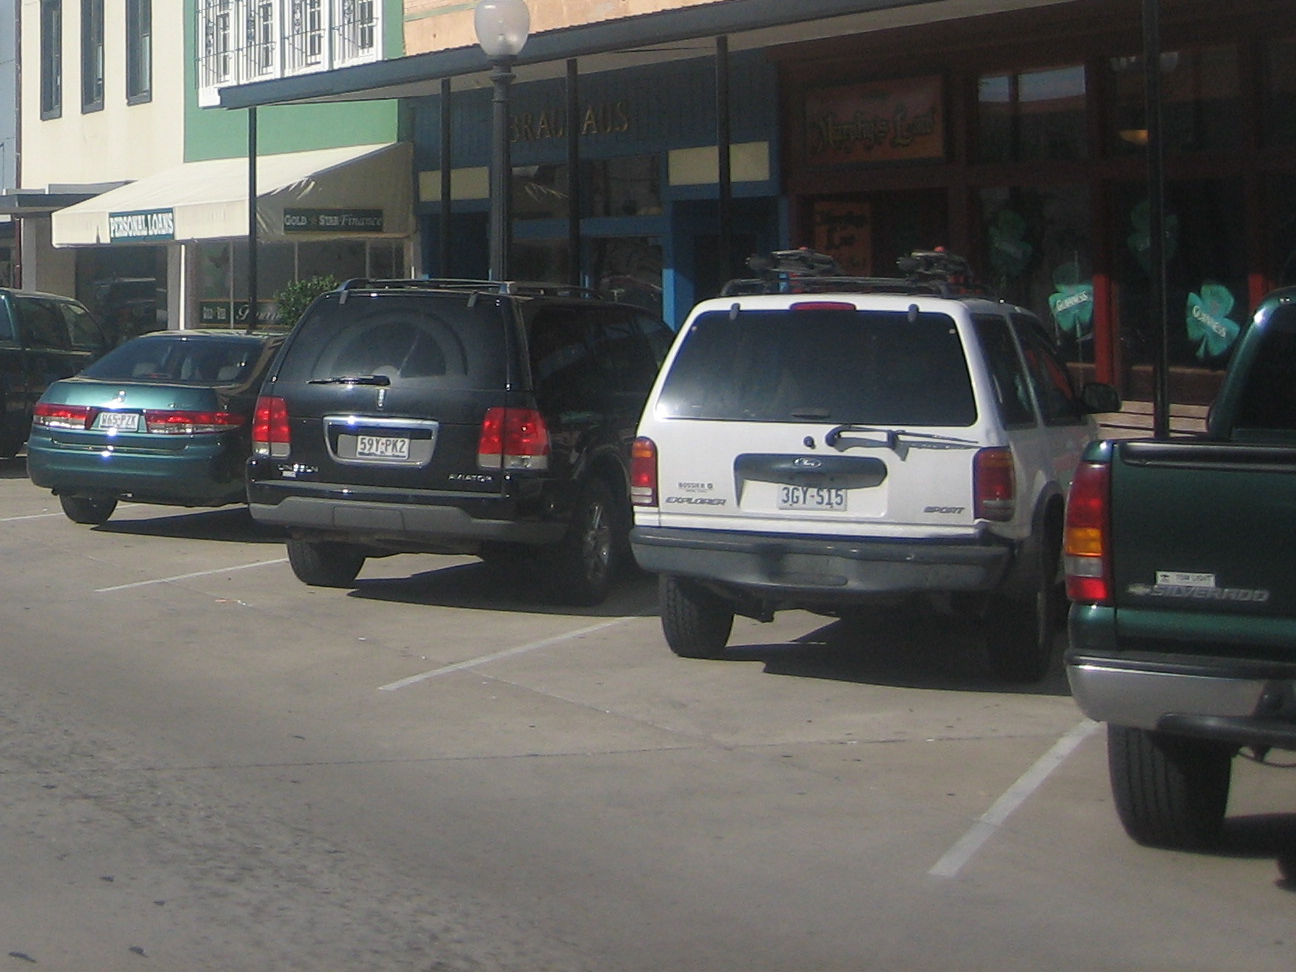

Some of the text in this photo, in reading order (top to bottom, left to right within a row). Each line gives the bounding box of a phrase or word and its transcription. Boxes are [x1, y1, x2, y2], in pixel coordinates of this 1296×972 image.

[284, 214, 307, 226] GOLD
[340, 213, 383, 226] Finance
[447, 473, 493, 482] AVIATOR
[665, 496, 727, 506] EXPLORER
[923, 505, 965, 515] SPORT
[1150, 584, 1271, 602] SILVERADO
